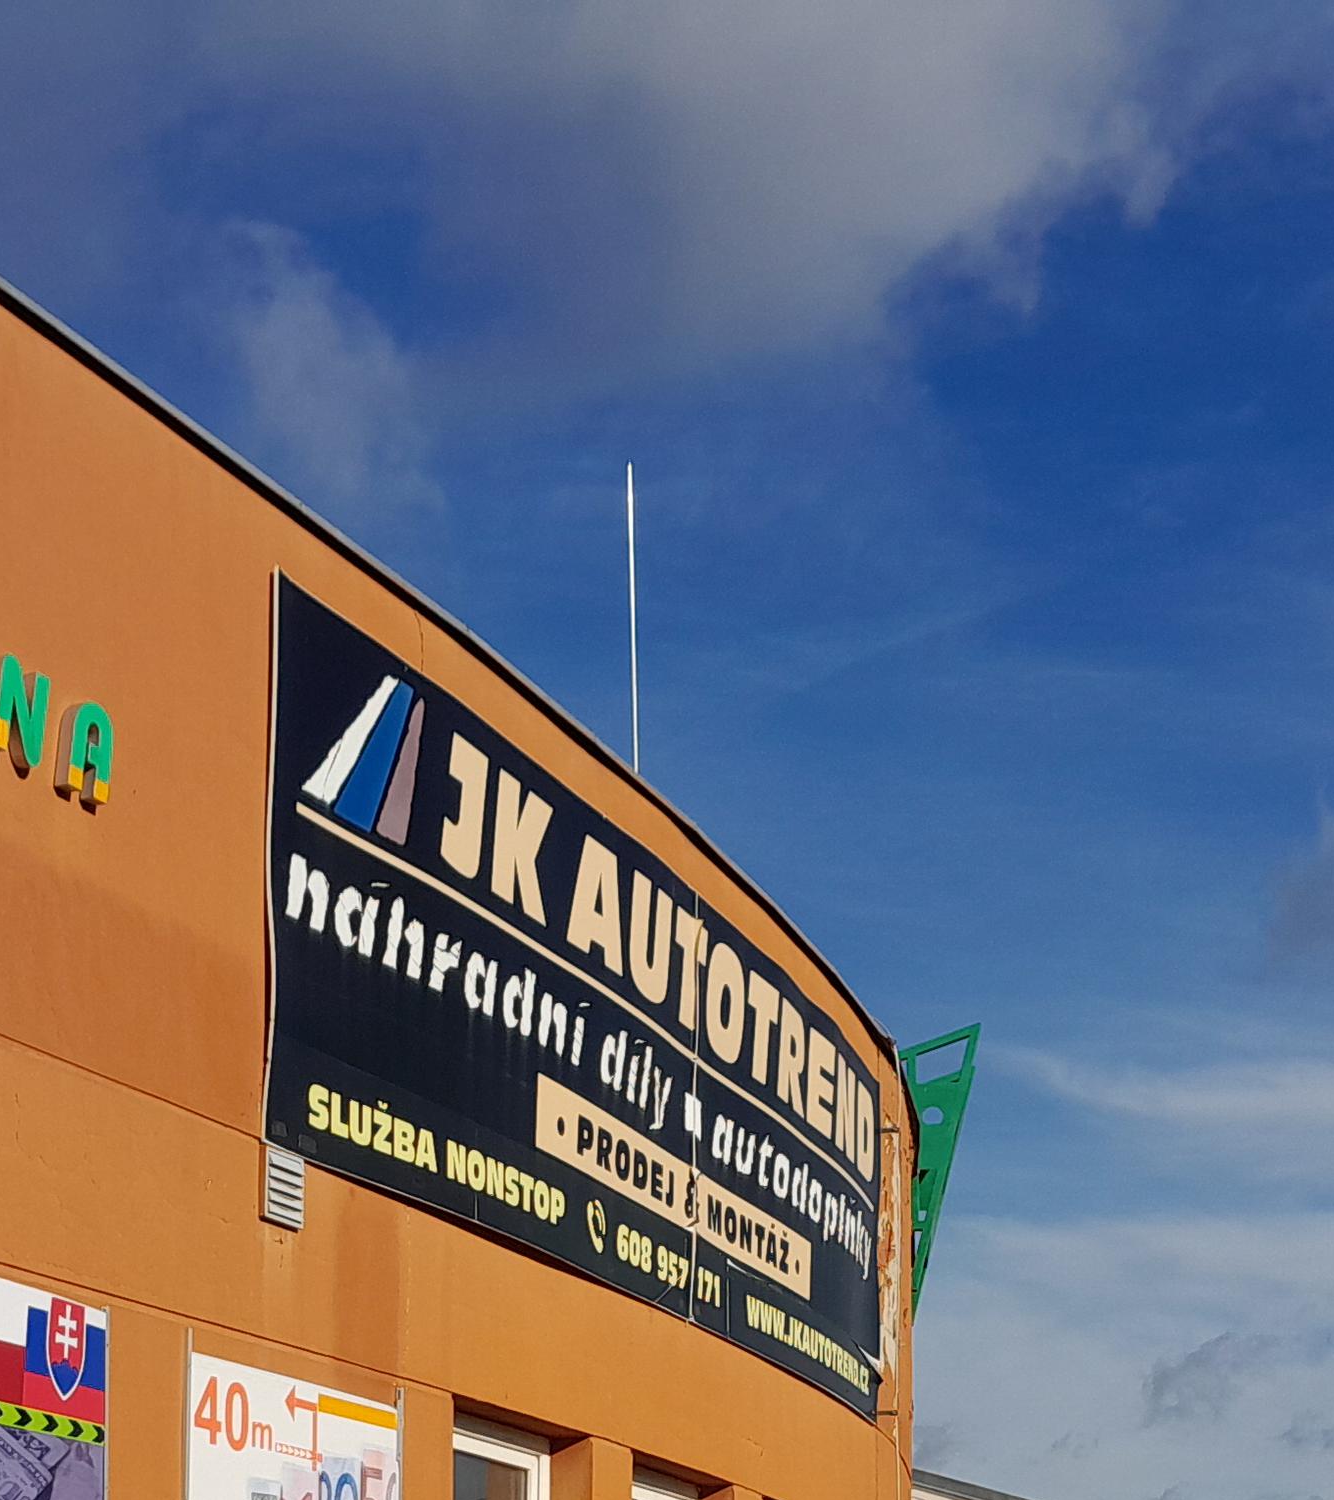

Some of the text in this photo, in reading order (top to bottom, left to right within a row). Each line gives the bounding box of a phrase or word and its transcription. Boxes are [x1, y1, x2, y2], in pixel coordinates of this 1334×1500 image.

[440, 731, 875, 1183] JK AUTOTREND
[308, 1083, 870, 1396] SLUŽBA NONSTOP 608 957 171 WWW.JKAUTOTREND.CZ
[578, 1114, 675, 1209] PRODEJ
[707, 1194, 790, 1276] MONTÁŽ
